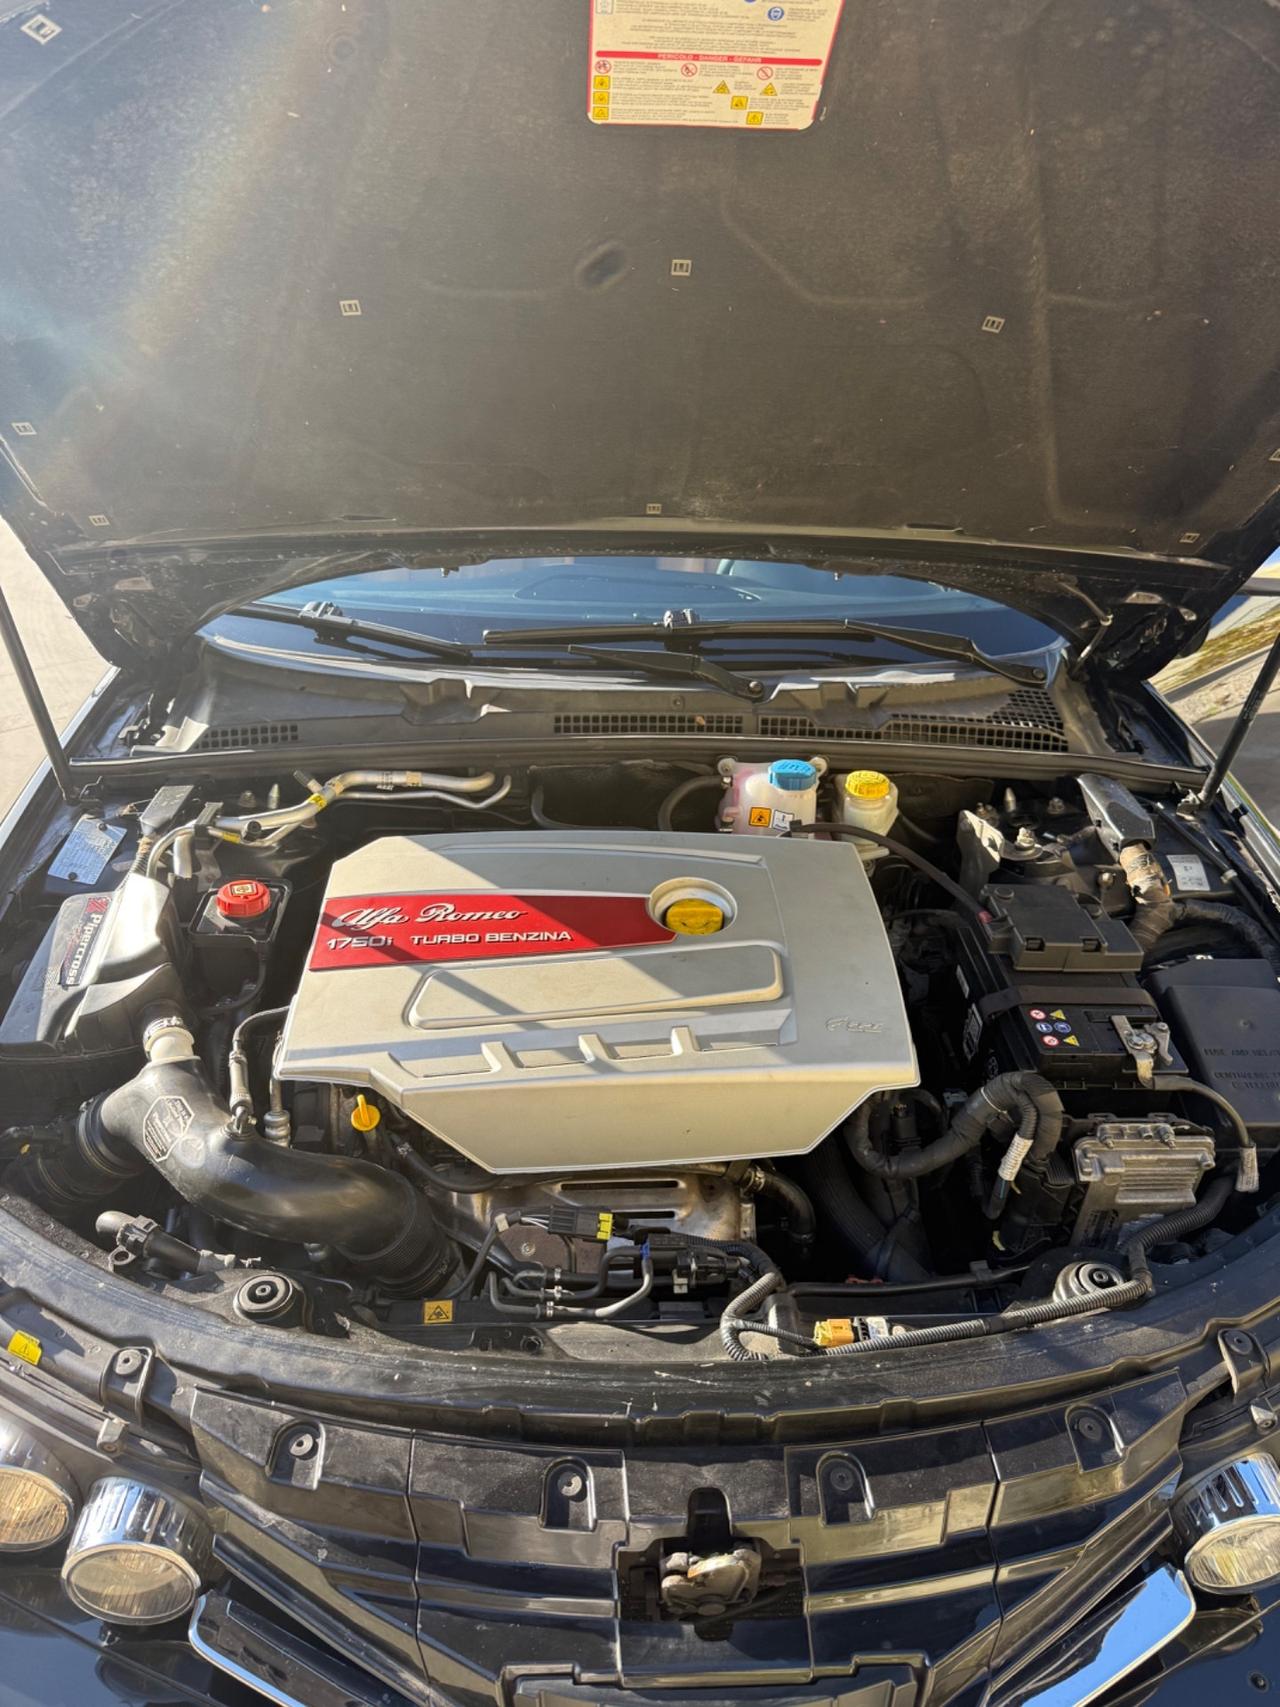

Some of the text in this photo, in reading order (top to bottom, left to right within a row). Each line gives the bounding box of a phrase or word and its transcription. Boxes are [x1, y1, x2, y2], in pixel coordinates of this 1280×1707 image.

[657, 53, 693, 61] PERICOLO
[699, 54, 728, 62] DANGER
[733, 56, 762, 64] GEFAHR
[331, 902, 528, 931] Alfa Romeo
[65, 913, 104, 985] Pipercross
[327, 931, 573, 950] 1750i TURBO BENZINA
